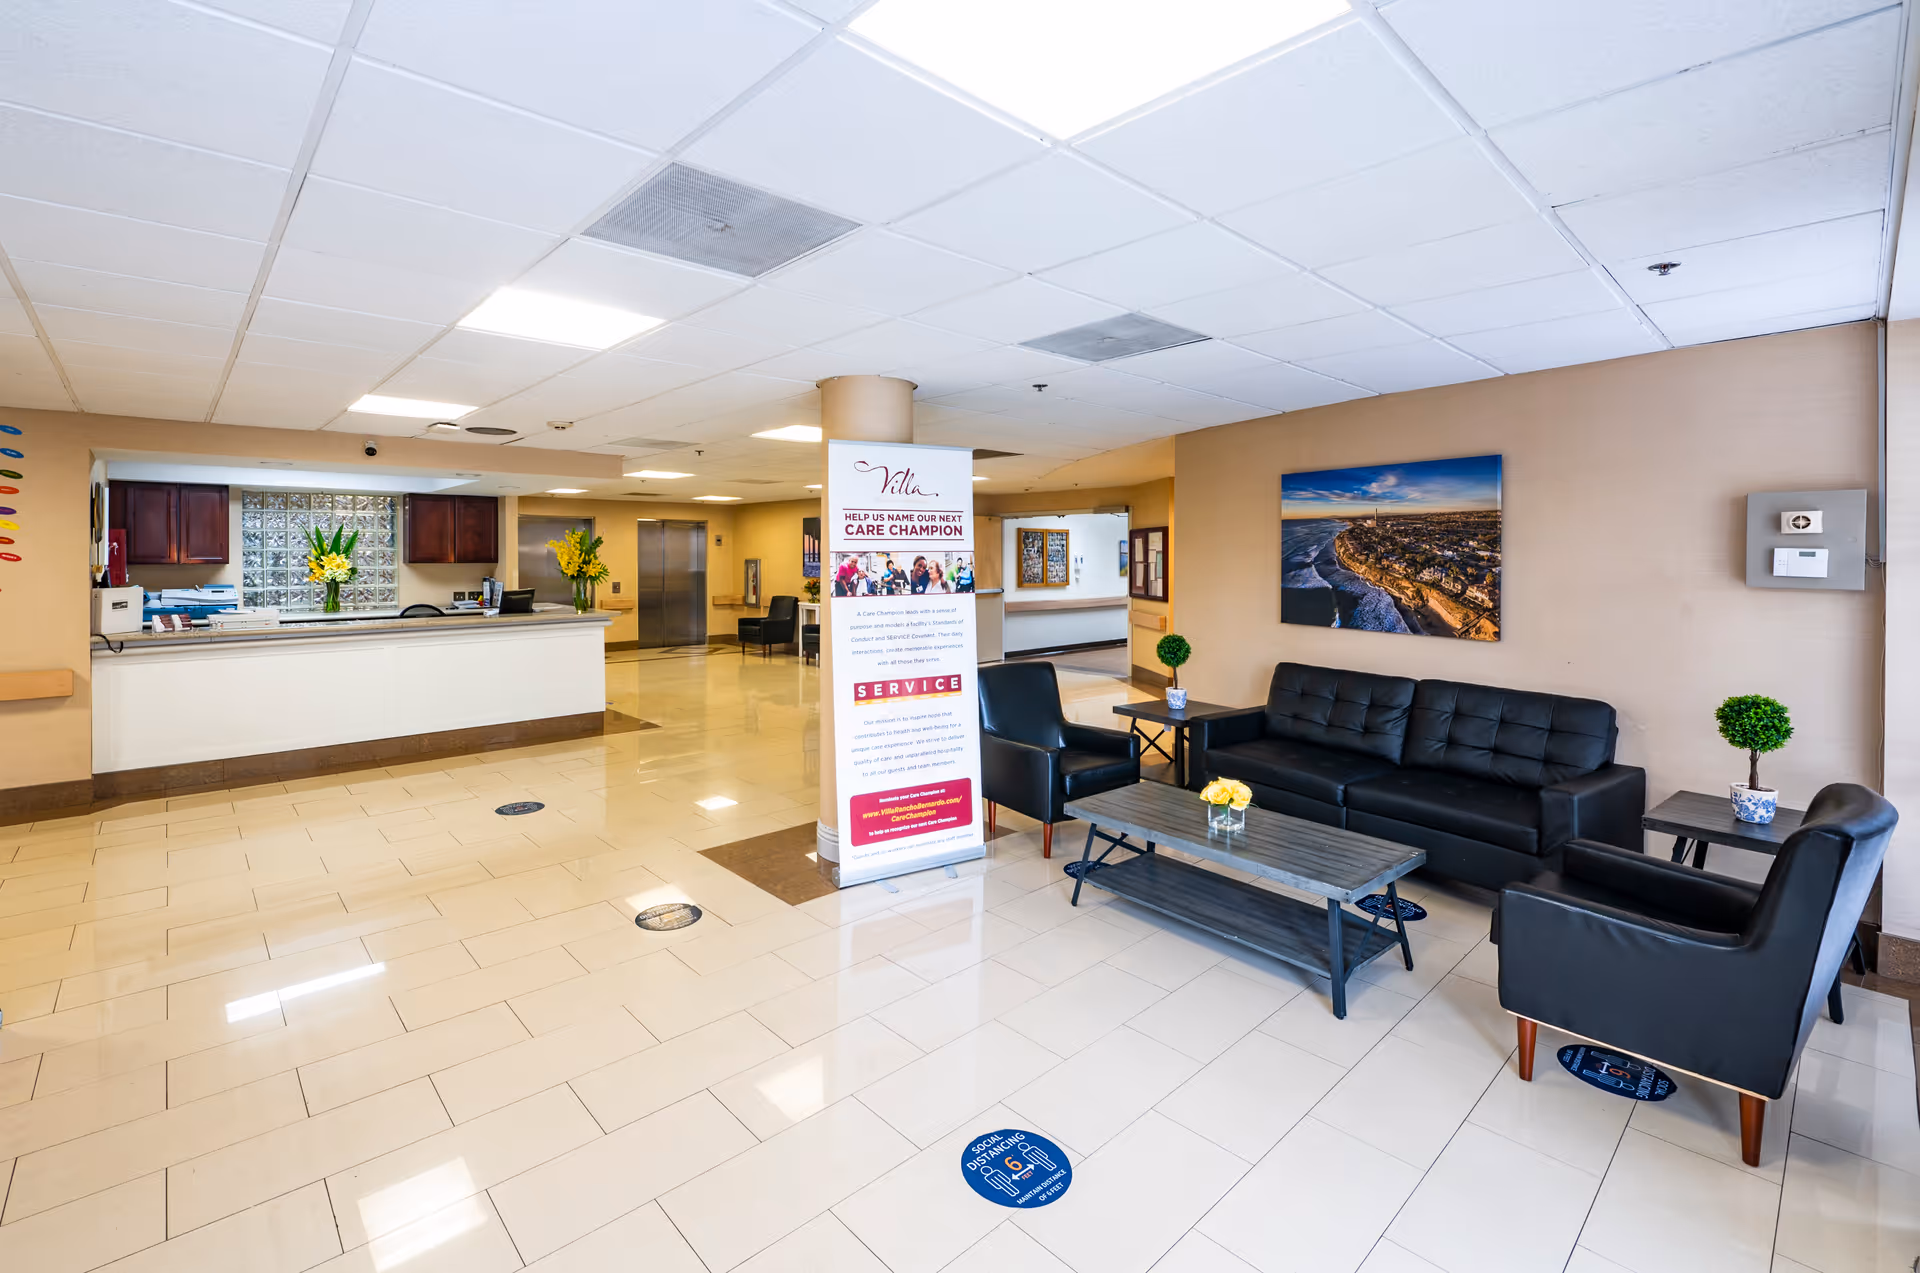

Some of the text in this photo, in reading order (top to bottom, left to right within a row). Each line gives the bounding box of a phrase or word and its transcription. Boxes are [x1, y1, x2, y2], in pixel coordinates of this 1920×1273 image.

[854, 460, 938, 496] Villa
[844, 513, 870, 521] HELP
[872, 514, 885, 522] US
[888, 514, 915, 522] NAME
[845, 524, 963, 536] CARE CHAMPION
[858, 678, 959, 697] SERVICE
[862, 794, 962, 819] www.VillaRanchoBernardo.com/
[891, 810, 936, 822] CareChampion
[1609, 1068, 1630, 1079] 6
[966, 1132, 1025, 1171] DISTANCING
[972, 1134, 1003, 1154] SOCIAL
[1004, 1156, 1022, 1171] 6
[1021, 1171, 1033, 1180] FEET
[1016, 1169, 1067, 1204] MAINTAIN DISTANCE
[1039, 1193, 1048, 1201] OF
[1050, 1182, 1064, 1193] FEET
